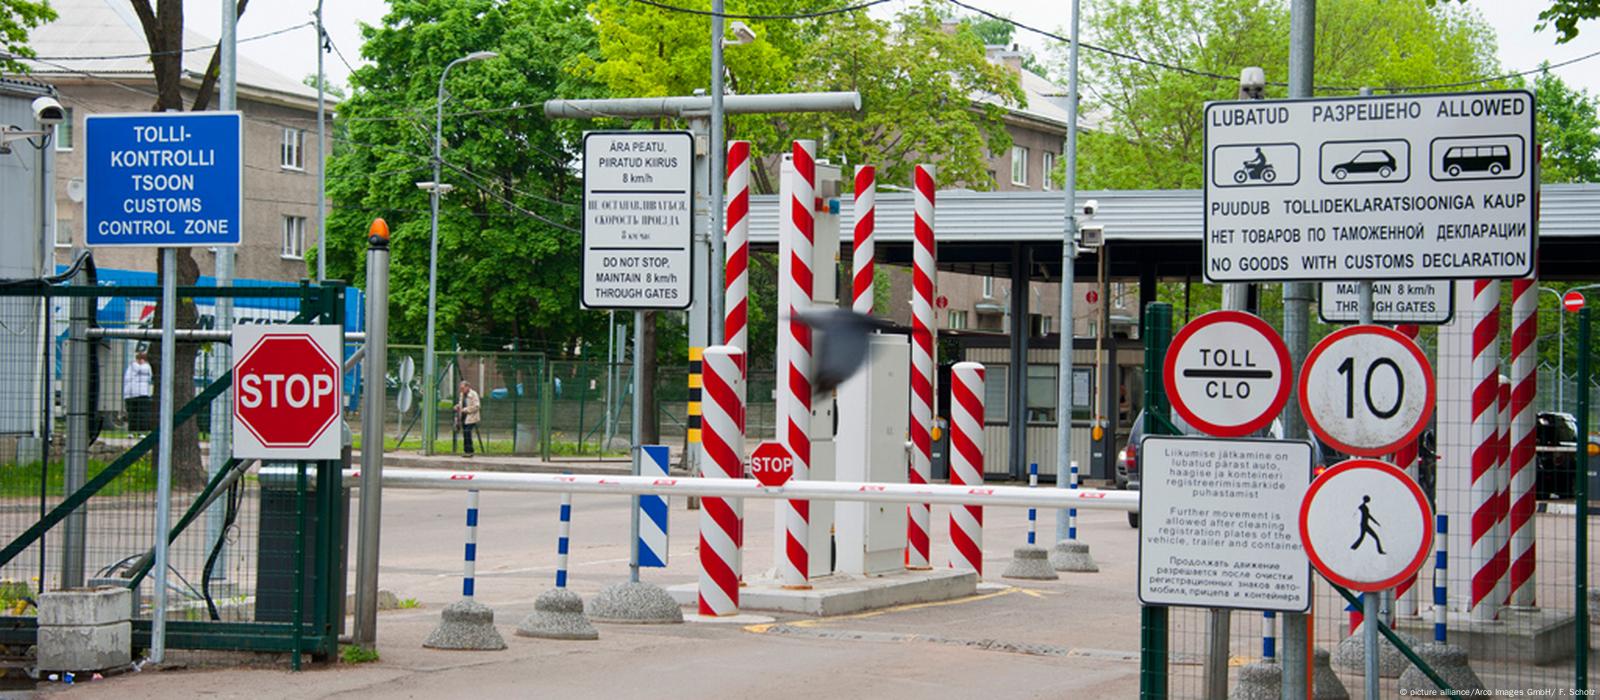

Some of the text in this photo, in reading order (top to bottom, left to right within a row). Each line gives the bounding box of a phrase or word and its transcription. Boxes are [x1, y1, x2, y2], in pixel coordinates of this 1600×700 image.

[1213, 98, 1525, 127] LUBATUD РАЗРЕШЕНО ALLOWED
[133, 125, 191, 143] TOLLI-
[609, 140, 631, 153] ÄRA
[111, 149, 214, 167] KONTROLLI
[599, 157, 678, 168] PIIRATUD KIIRUS
[132, 174, 194, 191] TSOON
[622, 173, 654, 183] 8 km/h
[123, 198, 202, 213] CUSTOMS
[1212, 193, 1526, 216] PUUDUB TOLLIDEKLARATSIOONIGA KAUP
[99, 220, 228, 235] CONTROL ZONE
[1212, 223, 1526, 244] НЕТ ТОВАРОВ ПО ТАМОЖЕННОЙ ДЕКЛАРАЦИИ
[603, 257, 618, 267] DO
[620, 257, 639, 267] NOT
[1212, 252, 1526, 272] NO GOODS WITH CUSTOMS DECLARATION
[596, 273, 677, 283] MAINTAIN 8 km/h
[595, 288, 678, 298] THROUGH GATES
[1337, 284, 1435, 295] MAIAIN 8 km/h
[1336, 301, 1436, 312] THRGH GATES
[1200, 349, 1257, 368] TOLL
[240, 374, 334, 409] STOP
[1206, 381, 1251, 399] CLO
[1337, 357, 1405, 419] 10
[1165, 448, 1288, 460] Liikumise jätkamine on
[752, 457, 792, 472] STOP
[1172, 458, 1212, 468] lubatud
[1215, 460, 1250, 470] pärast
[1169, 468, 1283, 480] haagise ja konteineri
[1166, 478, 1286, 490] registreerimismärkide
[1192, 488, 1259, 499] puhastamist
[1169, 507, 1280, 520] Further movement is
[1166, 516, 1285, 531] allowed after cleaning
[1158, 526, 1291, 541] registration plates of the
[1147, 536, 1189, 546] vehicle,
[1192, 538, 1225, 547] trailer
[1229, 539, 1248, 548] and
[1169, 556, 1280, 570] Продолжать движение
[1157, 566, 1217, 576] разрешается
[1256, 572, 1293, 580] очистки
[1245, 592, 1300, 601] контейнера
